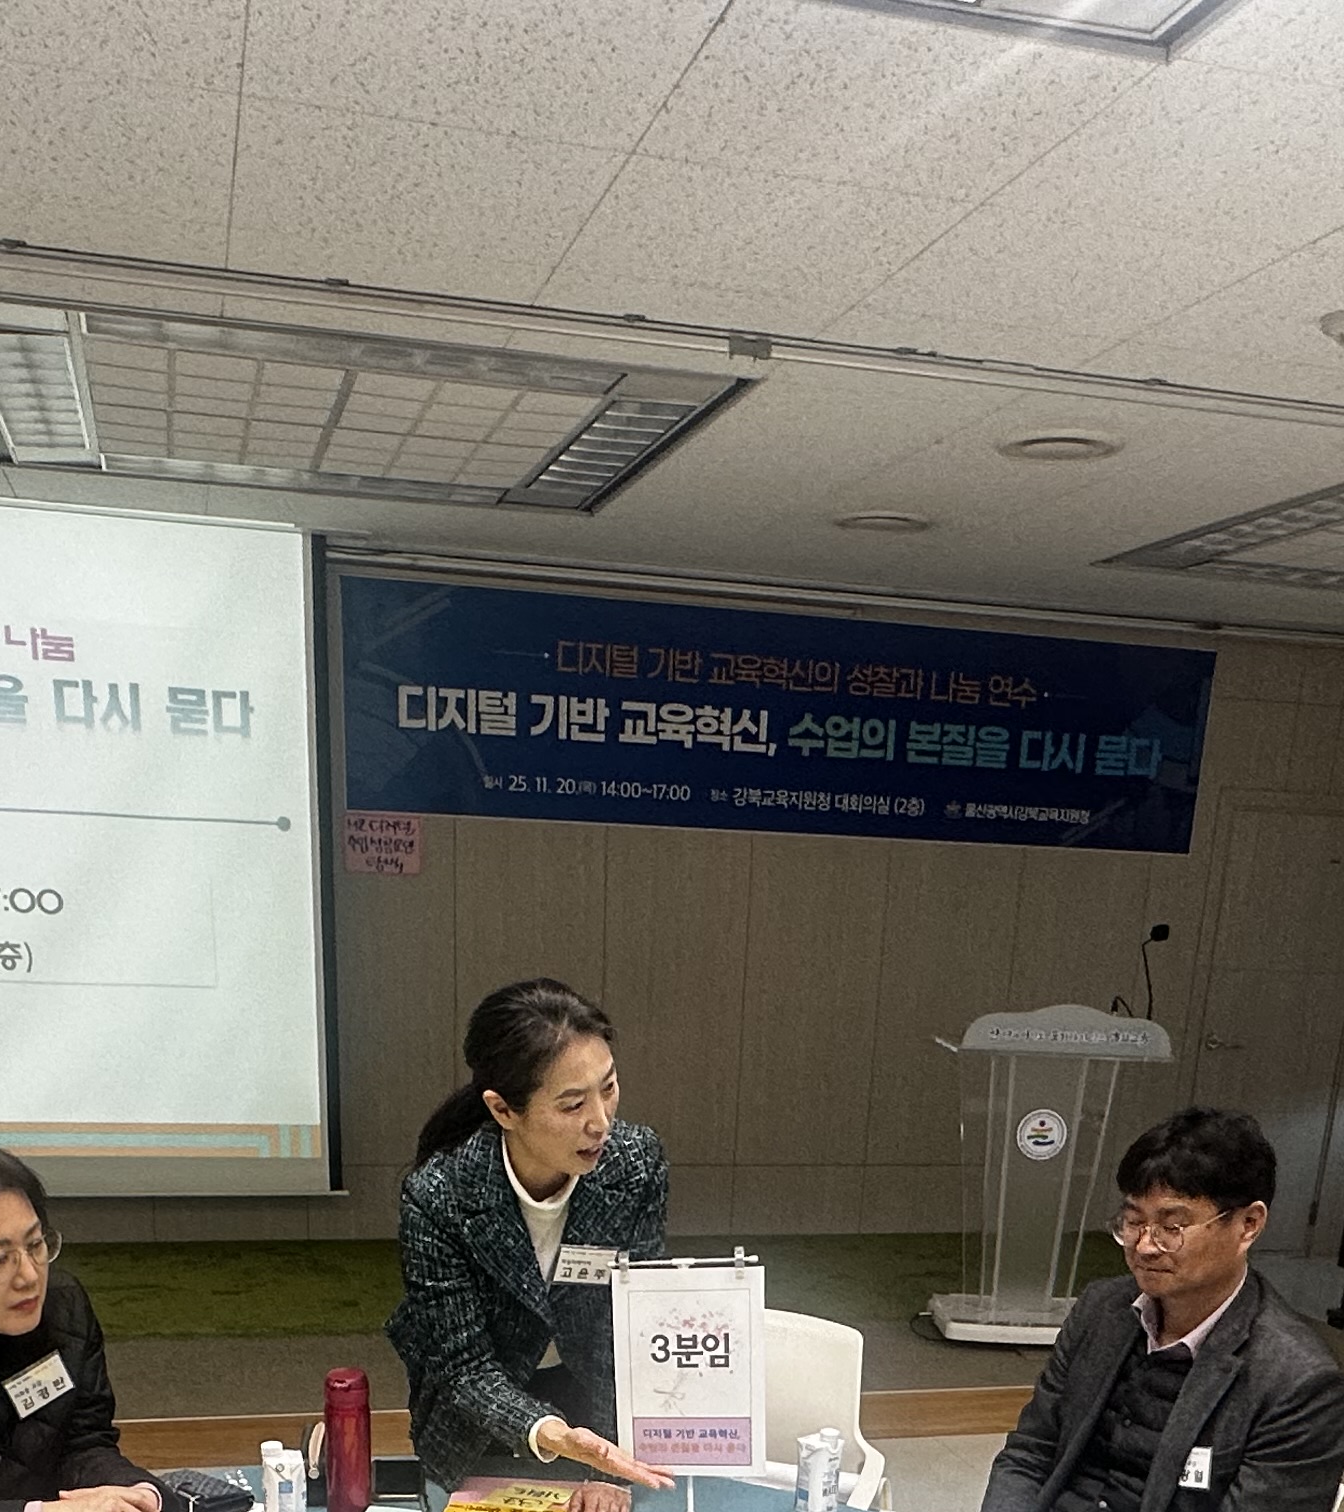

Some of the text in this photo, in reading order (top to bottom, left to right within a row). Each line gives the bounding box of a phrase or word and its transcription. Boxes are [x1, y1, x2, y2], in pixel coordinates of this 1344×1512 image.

[4, 624, 75, 662] 나눔
[557, 639, 1037, 709] 디지털 기반 교육혁신의 성찰과 나눔 연수
[53, 679, 143, 733] 다시
[166, 686, 254, 738] 묻다
[398, 684, 1162, 780] 디지털 기반 교육혁신, 수업의 본질을 다시 묻다
[508, 775, 531, 792] 25.
[536, 777, 551, 793] 11.
[600, 780, 690, 801] 14:00~17:00
[732, 787, 831, 811] 강북교육지원청
[834, 793, 891, 815] 대회의실
[893, 796, 925, 816] (2층)
[650, 1332, 730, 1368] 3분임
[643, 1428, 672, 1439] 디지털
[676, 1428, 695, 1439] 기반
